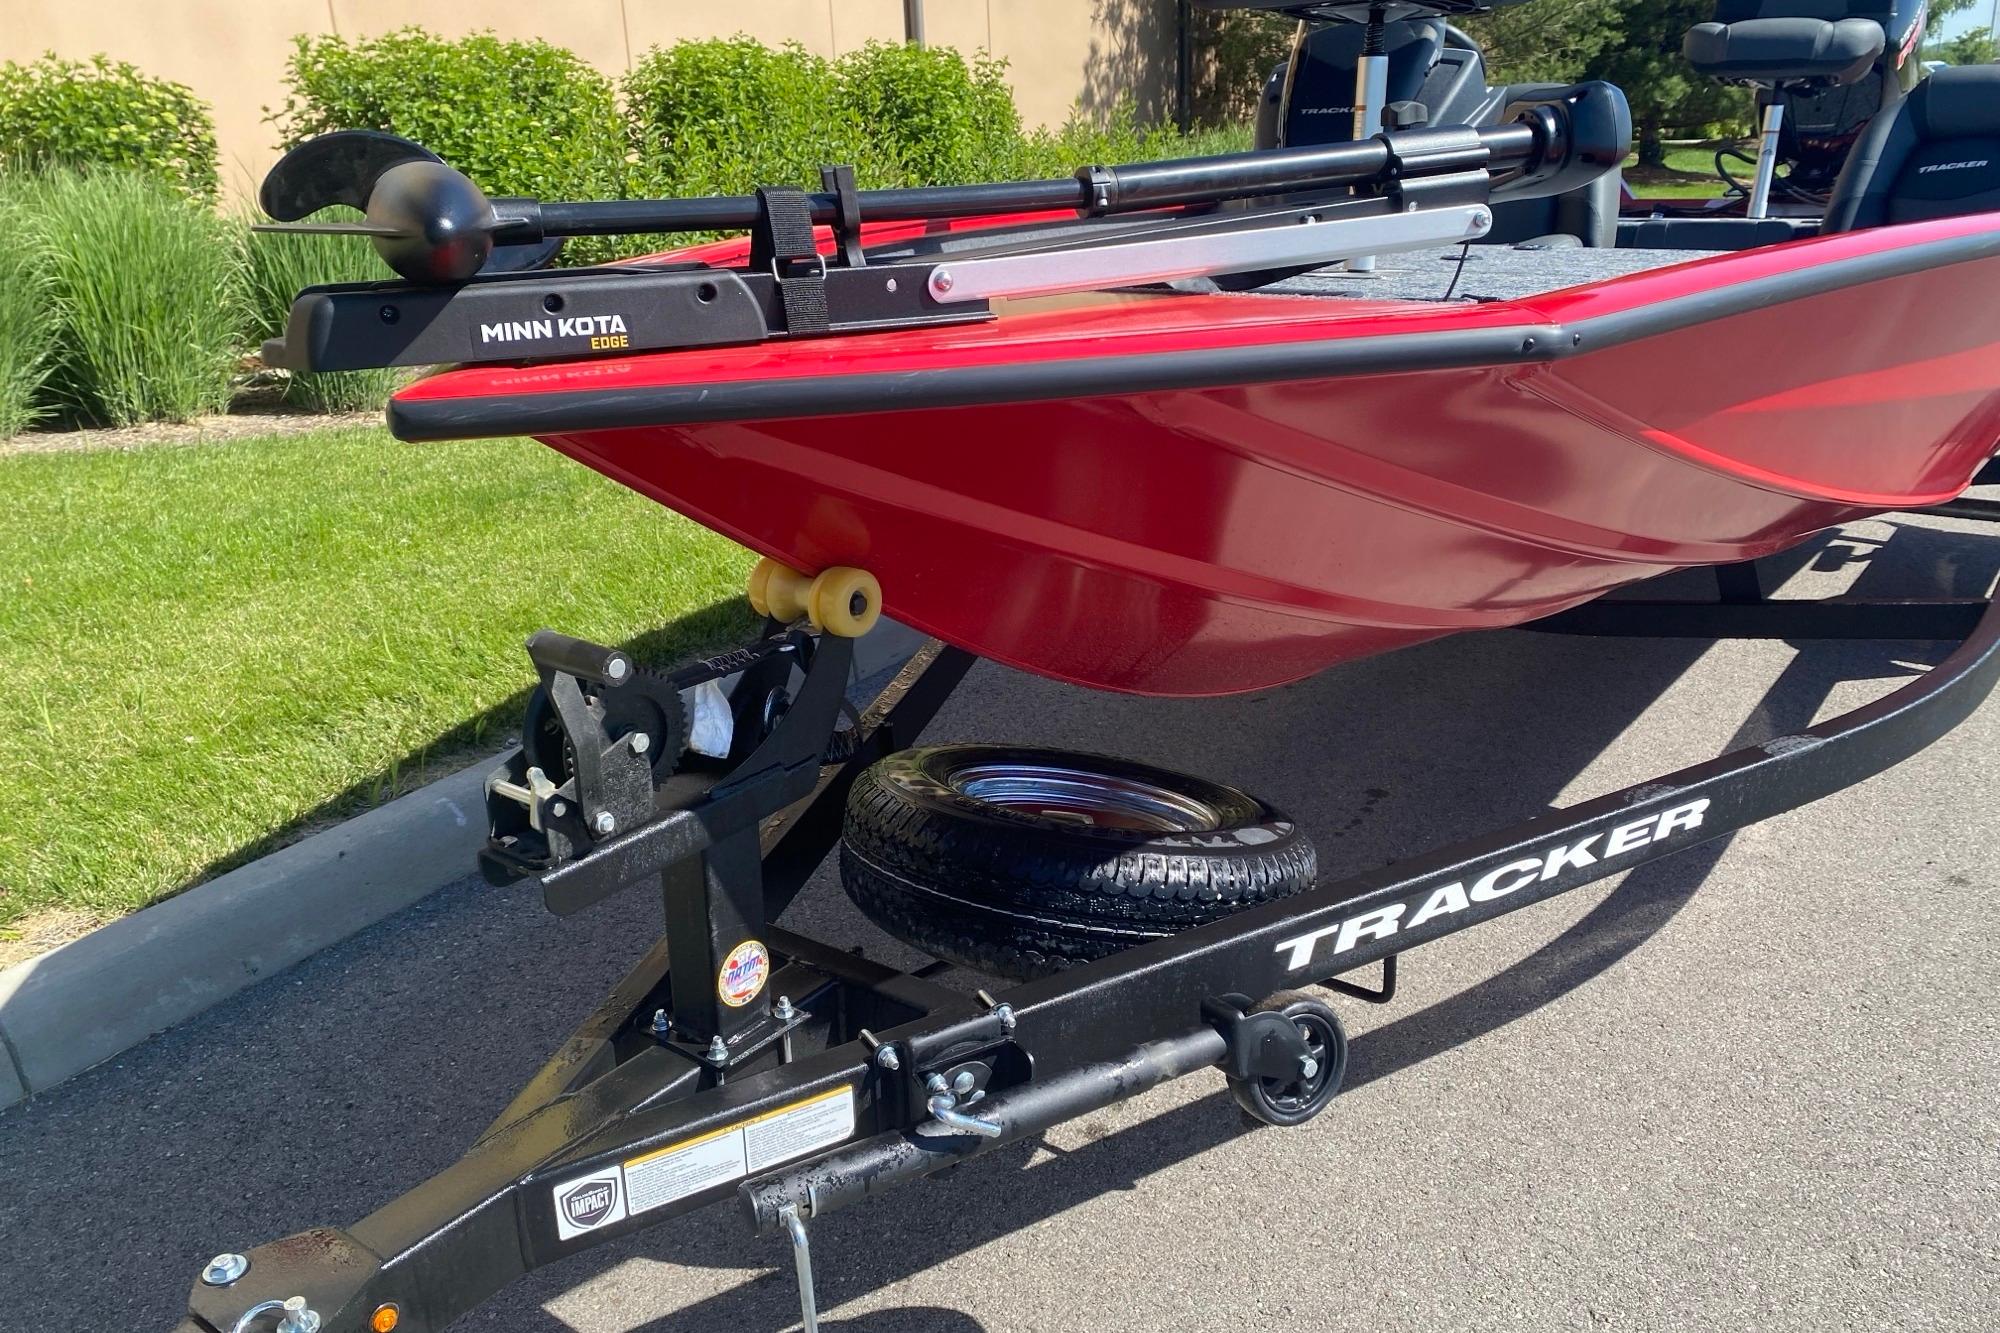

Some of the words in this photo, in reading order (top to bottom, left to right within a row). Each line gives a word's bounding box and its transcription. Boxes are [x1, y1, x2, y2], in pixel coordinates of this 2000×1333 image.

[1919, 160, 1989, 174] TRACKER
[480, 318, 553, 343] MINN
[558, 314, 627, 338] KOTA
[590, 335, 629, 350] EDGE
[1274, 798, 1711, 972] TRACKER
[570, 1190, 610, 1218] IMPACT
